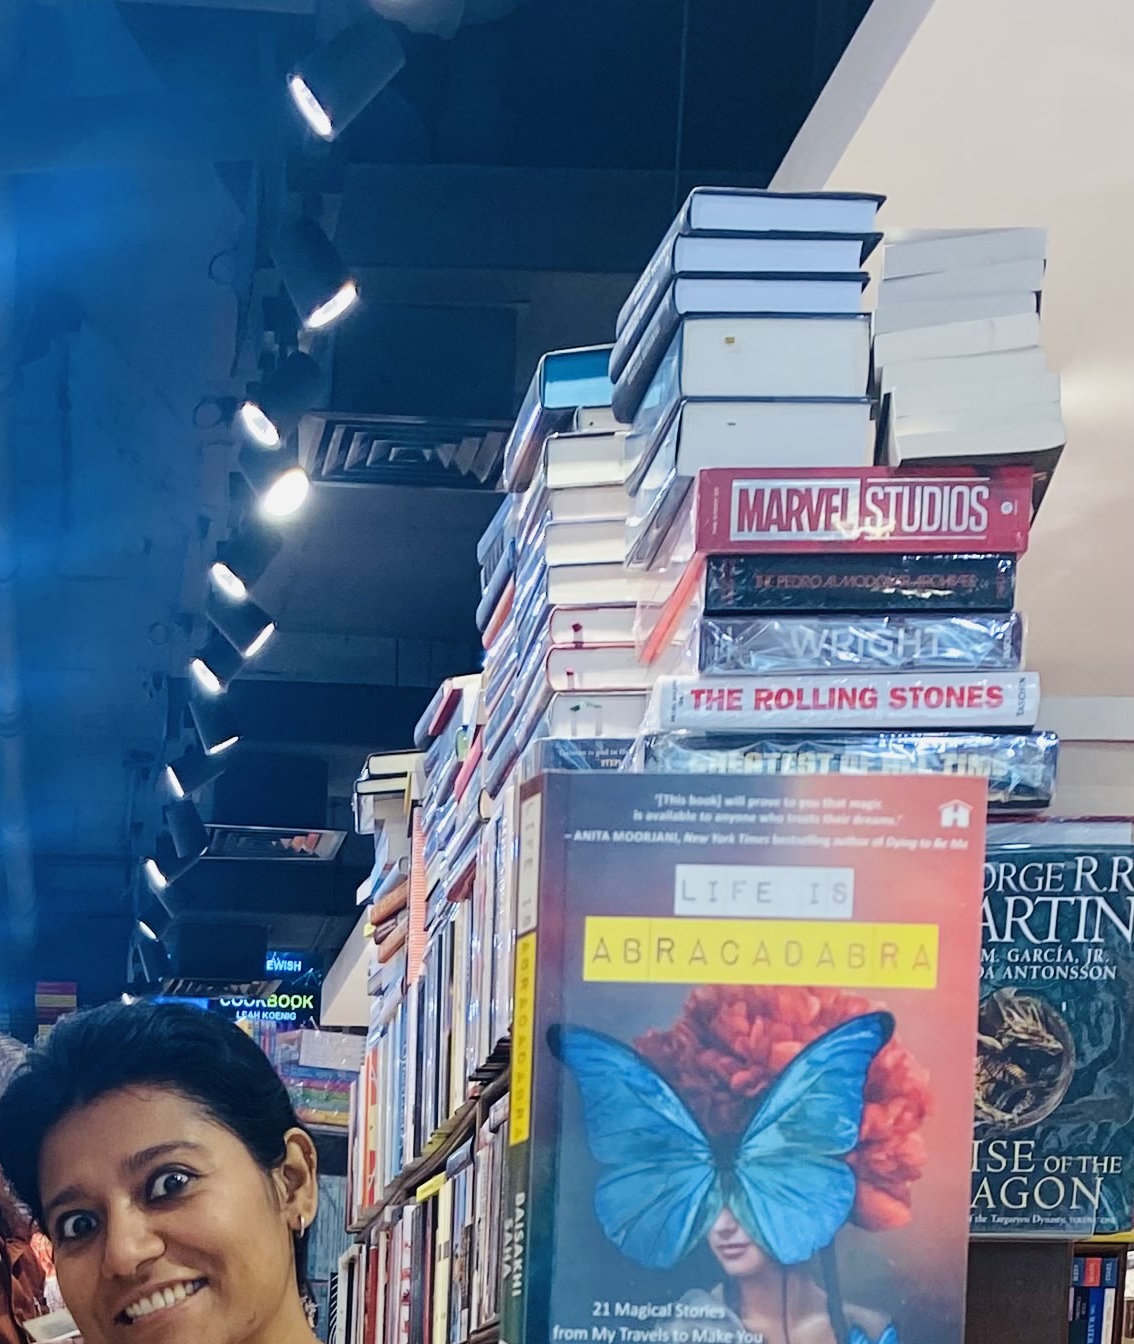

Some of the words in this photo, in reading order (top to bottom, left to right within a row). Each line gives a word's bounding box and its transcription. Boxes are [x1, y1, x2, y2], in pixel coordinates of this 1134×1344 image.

[737, 487, 849, 532] MARVEL
[866, 485, 990, 533] STUDIOS
[790, 627, 942, 659] WRIGHT
[691, 689, 744, 711] THE
[754, 687, 878, 710] ROLLING
[889, 686, 1004, 709] STONES
[983, 862, 1065, 892] ORGE
[682, 880, 772, 903] LIFE
[810, 882, 848, 905] IS
[979, 896, 1134, 944] ARTIN
[266, 960, 301, 971] EWISH
[592, 937, 932, 973] ABRACADABRA
[1007, 944, 1079, 963] GARCÍA,
[1085, 948, 1109, 966] JR.
[1003, 966, 1117, 980] ANTONSSON
[236, 1011, 260, 1019] LEAH
[262, 1011, 296, 1020] KOENIG
[971, 1140, 1035, 1173] ISE
[1044, 1156, 1072, 1173] OF
[1078, 1156, 1122, 1173] THE
[970, 1176, 1104, 1210] AGON
[592, 1302, 610, 1317] 21
[615, 1302, 672, 1320] Magical
[675, 1303, 726, 1319] Stories
[552, 1325, 588, 1341] from
[592, 1327, 615, 1344] My
[620, 1327, 669, 1343] Travels
[672, 1329, 688, 1343] to
[692, 1328, 733, 1344] Make
[737, 1329, 763, 1344] You
